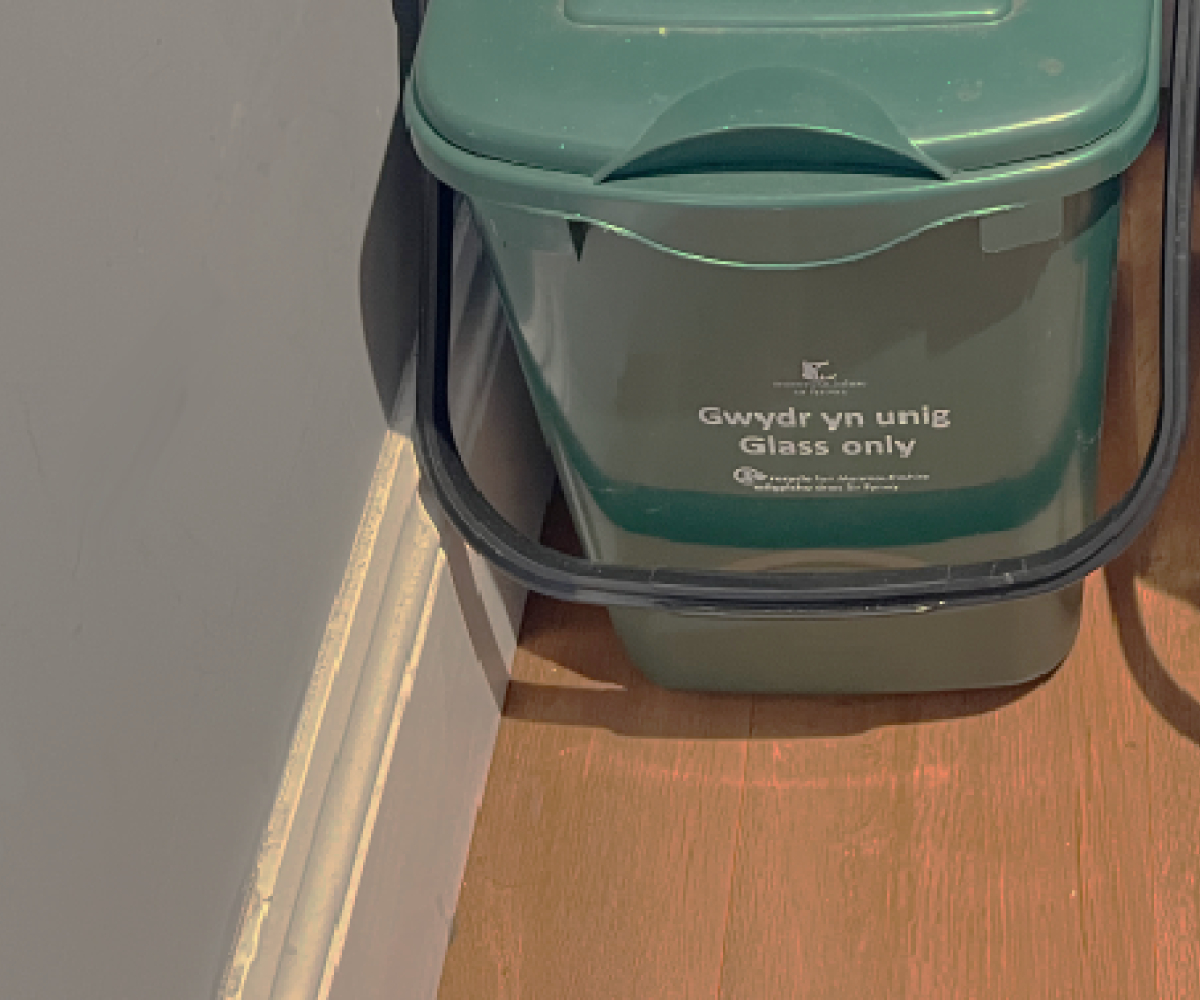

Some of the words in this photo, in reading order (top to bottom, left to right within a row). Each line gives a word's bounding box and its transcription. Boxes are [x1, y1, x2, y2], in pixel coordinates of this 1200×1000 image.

[698, 406, 811, 431] Gwydr
[820, 410, 863, 431] yn
[875, 404, 951, 428] unig
[739, 434, 829, 455] Glass
[841, 434, 916, 458] only
